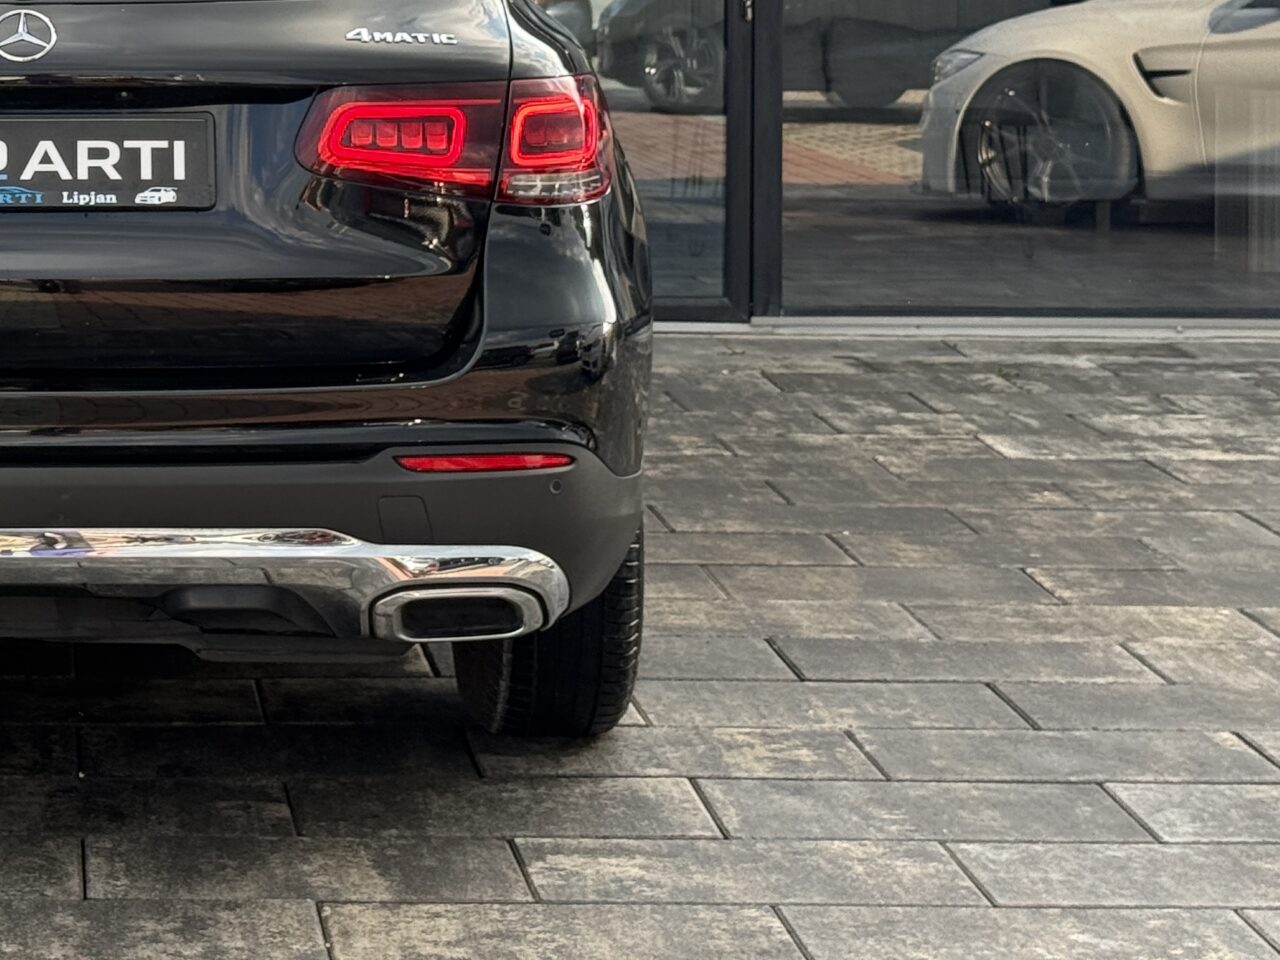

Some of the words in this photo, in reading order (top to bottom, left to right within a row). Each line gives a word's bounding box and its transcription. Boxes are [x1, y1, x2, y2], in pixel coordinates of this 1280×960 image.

[345, 27, 458, 45] 4MATIC
[19, 140, 186, 181] ARTI
[61, 191, 118, 206] Lipjan
